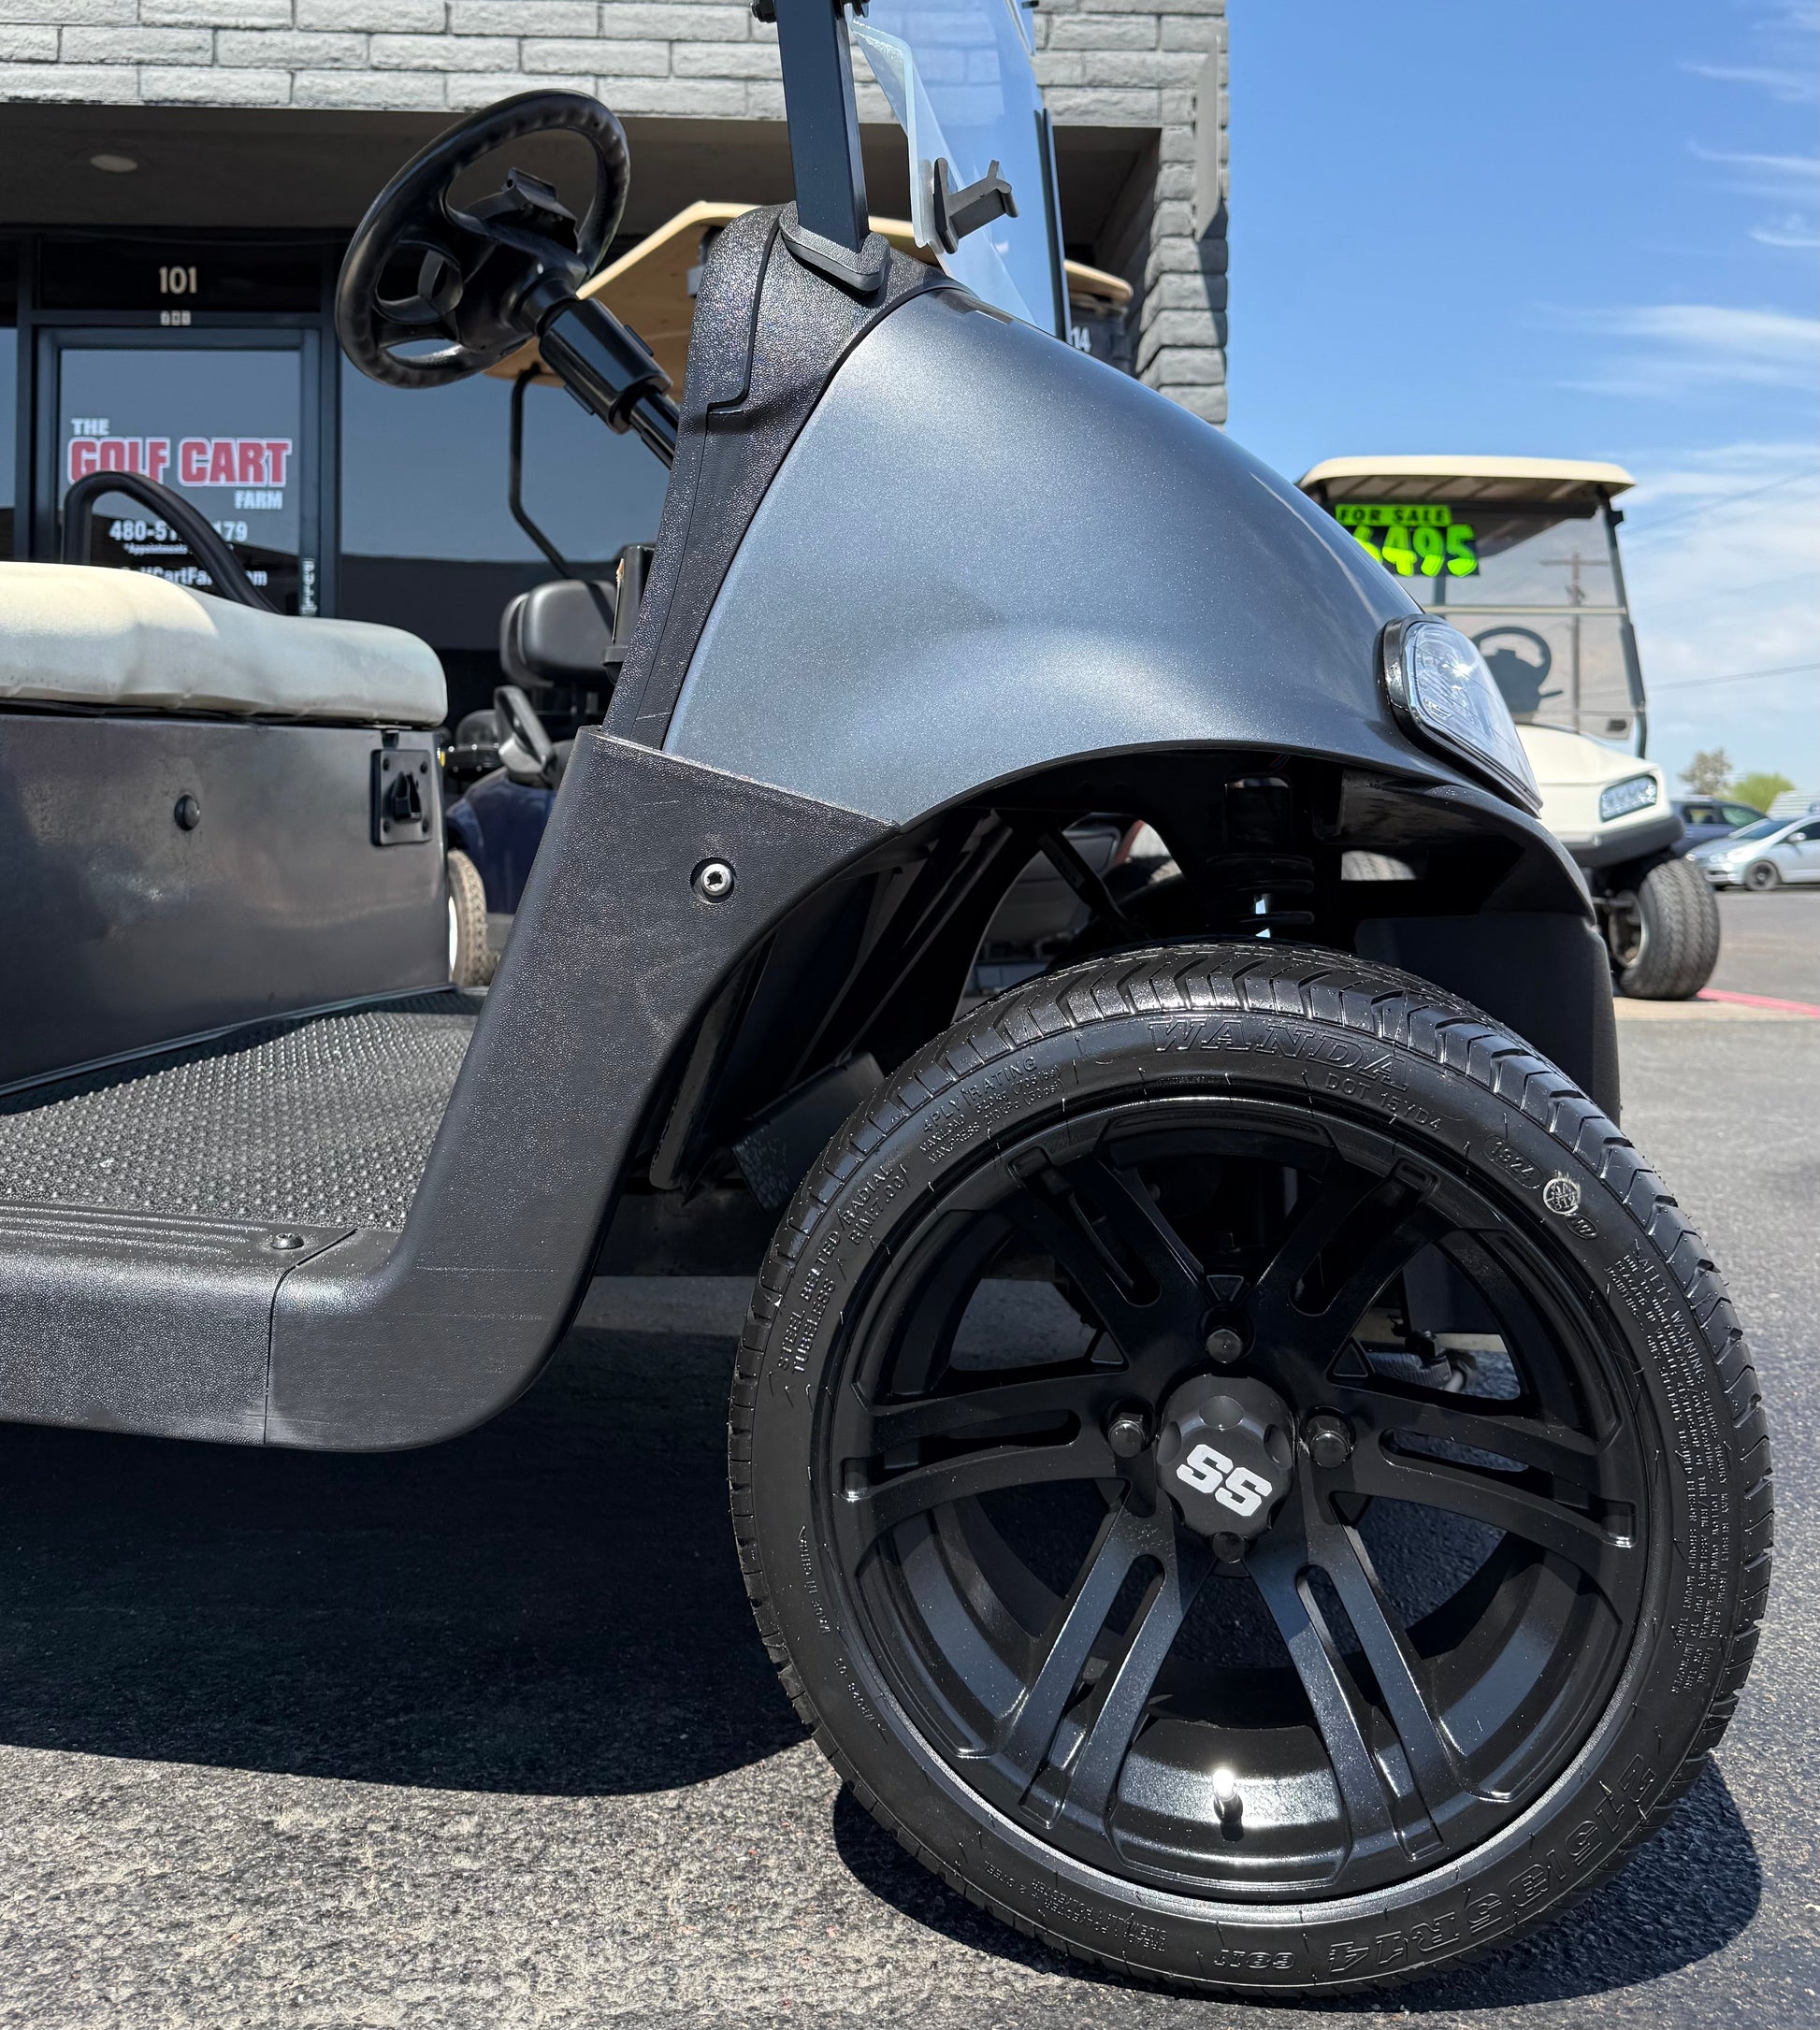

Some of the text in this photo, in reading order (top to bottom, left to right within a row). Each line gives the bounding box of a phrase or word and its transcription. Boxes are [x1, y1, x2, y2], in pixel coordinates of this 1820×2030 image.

[159, 266, 197, 295] 101
[70, 417, 110, 436] THE
[67, 437, 293, 488] GOLF CART
[235, 490, 283, 511] FARM
[1339, 509, 1449, 522] FOR SALE
[1148, 1018, 1408, 1091] WANDA
[922, 1057, 1038, 1133] 4PLY RATING
[1324, 1073, 1372, 1103] DOT
[777, 1165, 894, 1371] STEEL BELTED RADIAL
[791, 1277, 837, 1374] TUBELESS
[1633, 1251, 1674, 1305] SAFETY
[1671, 1310, 1707, 1385] WARNING:
[1176, 1444, 1273, 1517] SS
